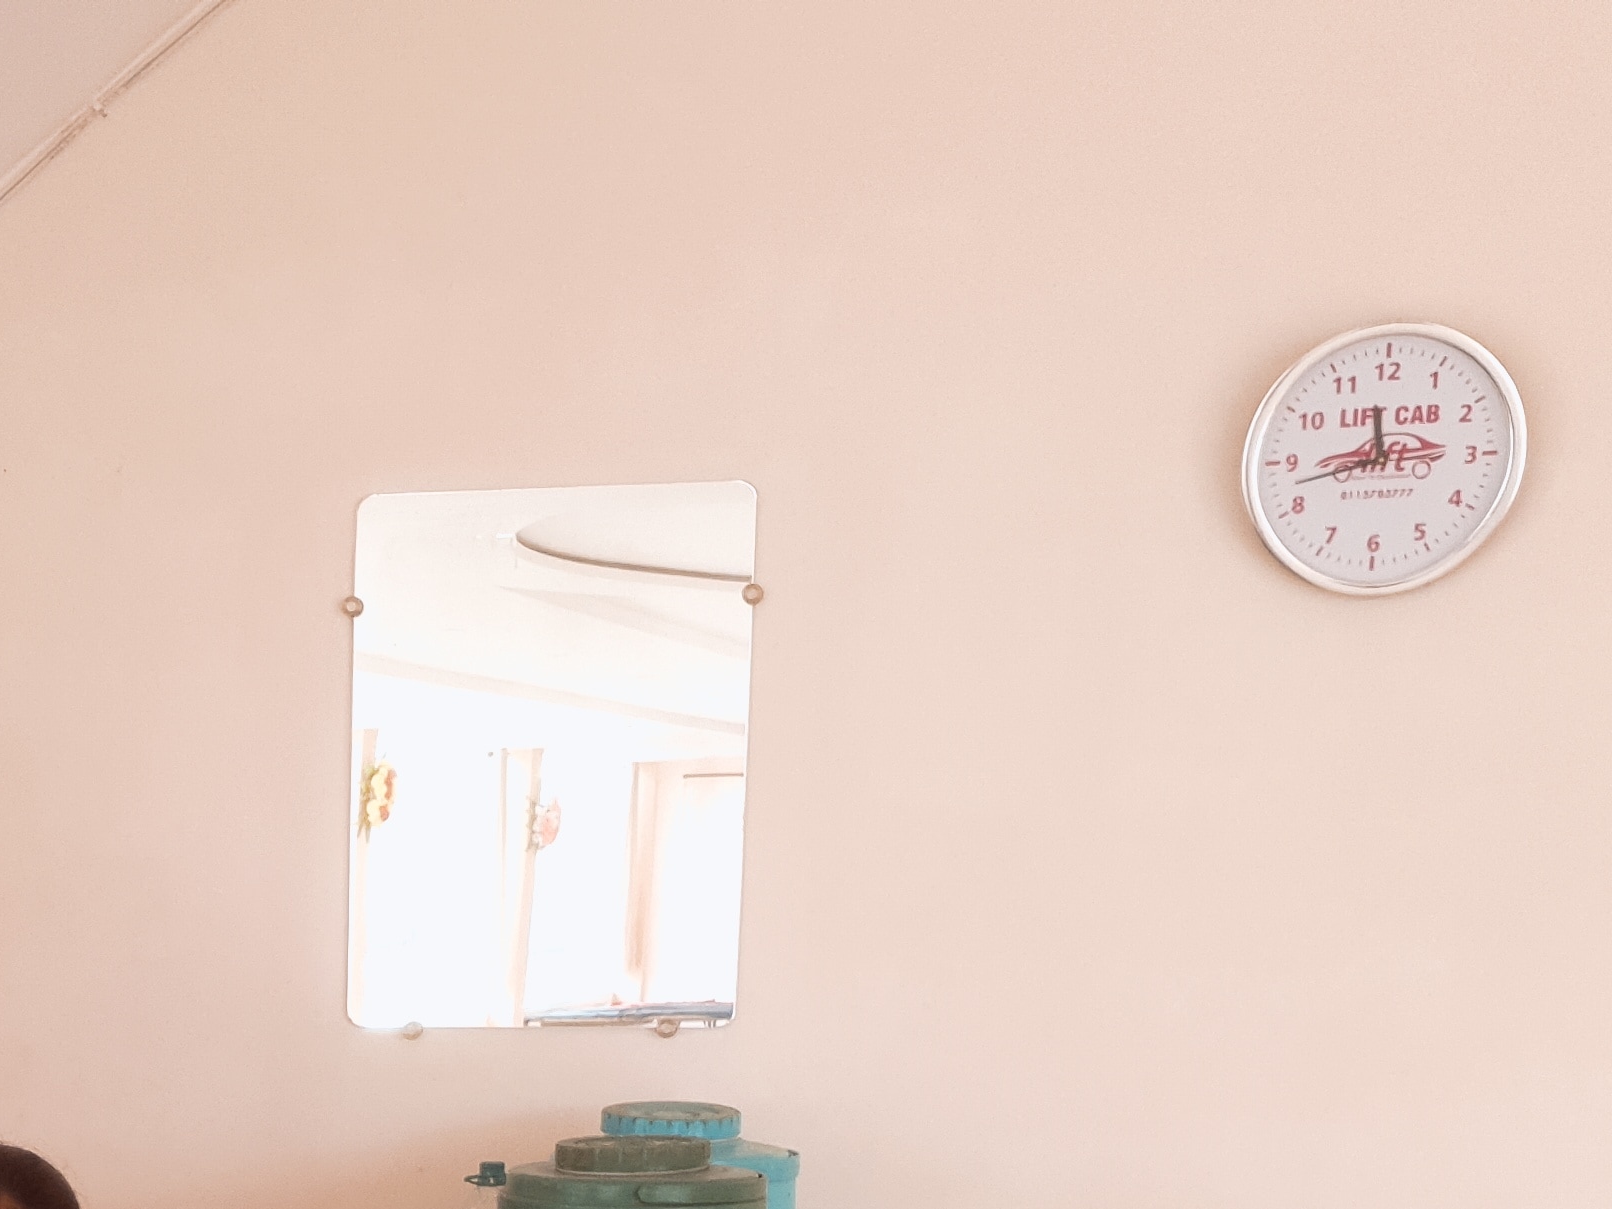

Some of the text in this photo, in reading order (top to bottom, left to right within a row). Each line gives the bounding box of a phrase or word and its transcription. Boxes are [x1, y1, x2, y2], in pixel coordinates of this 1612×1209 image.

[1375, 362, 1401, 382] 12
[1429, 371, 1439, 390] 1
[1333, 376, 1357, 395] 11
[1299, 411, 1325, 431] 10
[1340, 404, 1441, 428] LIF CAB
[1458, 404, 1474, 424] 2
[1285, 453, 1299, 473] 9
[1464, 446, 1478, 465] 3
[1291, 496, 1306, 515] 8
[1448, 489, 1464, 508] 4
[1324, 526, 1338, 545] 7
[1413, 523, 1427, 542] 5
[1366, 534, 1381, 553] 6
